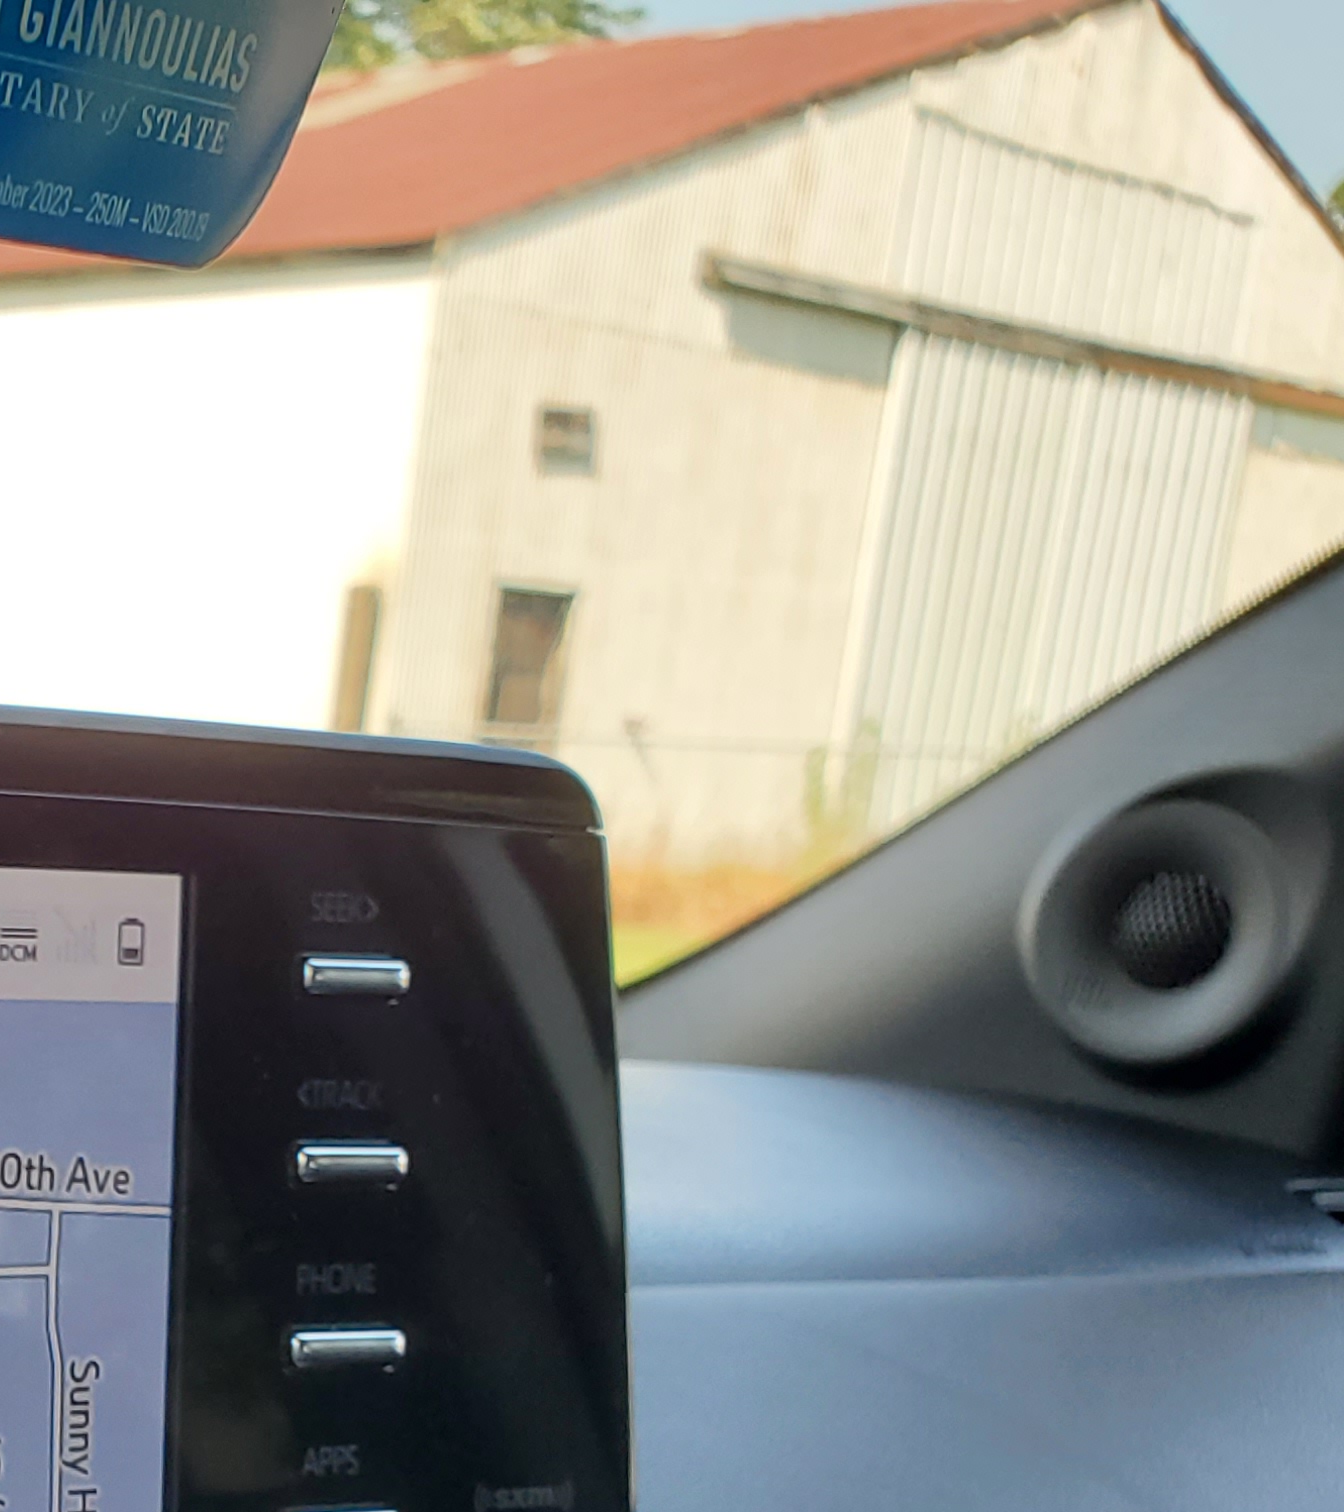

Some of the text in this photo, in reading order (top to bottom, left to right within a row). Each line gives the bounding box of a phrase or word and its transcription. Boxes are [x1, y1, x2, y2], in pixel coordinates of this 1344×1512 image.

[18, 0, 258, 93] GIANNOULIAS
[101, 96, 128, 135] of
[136, 104, 230, 156] STATE
[29, 180, 73, 218] 2023
[85, 192, 131, 228] 250M
[141, 202, 170, 235] VSD
[66, 1155, 132, 1197] Ave
[296, 1263, 377, 1295] PHONE
[61, 1359, 100, 1475] Sunny
[302, 1445, 359, 1476] APPS
